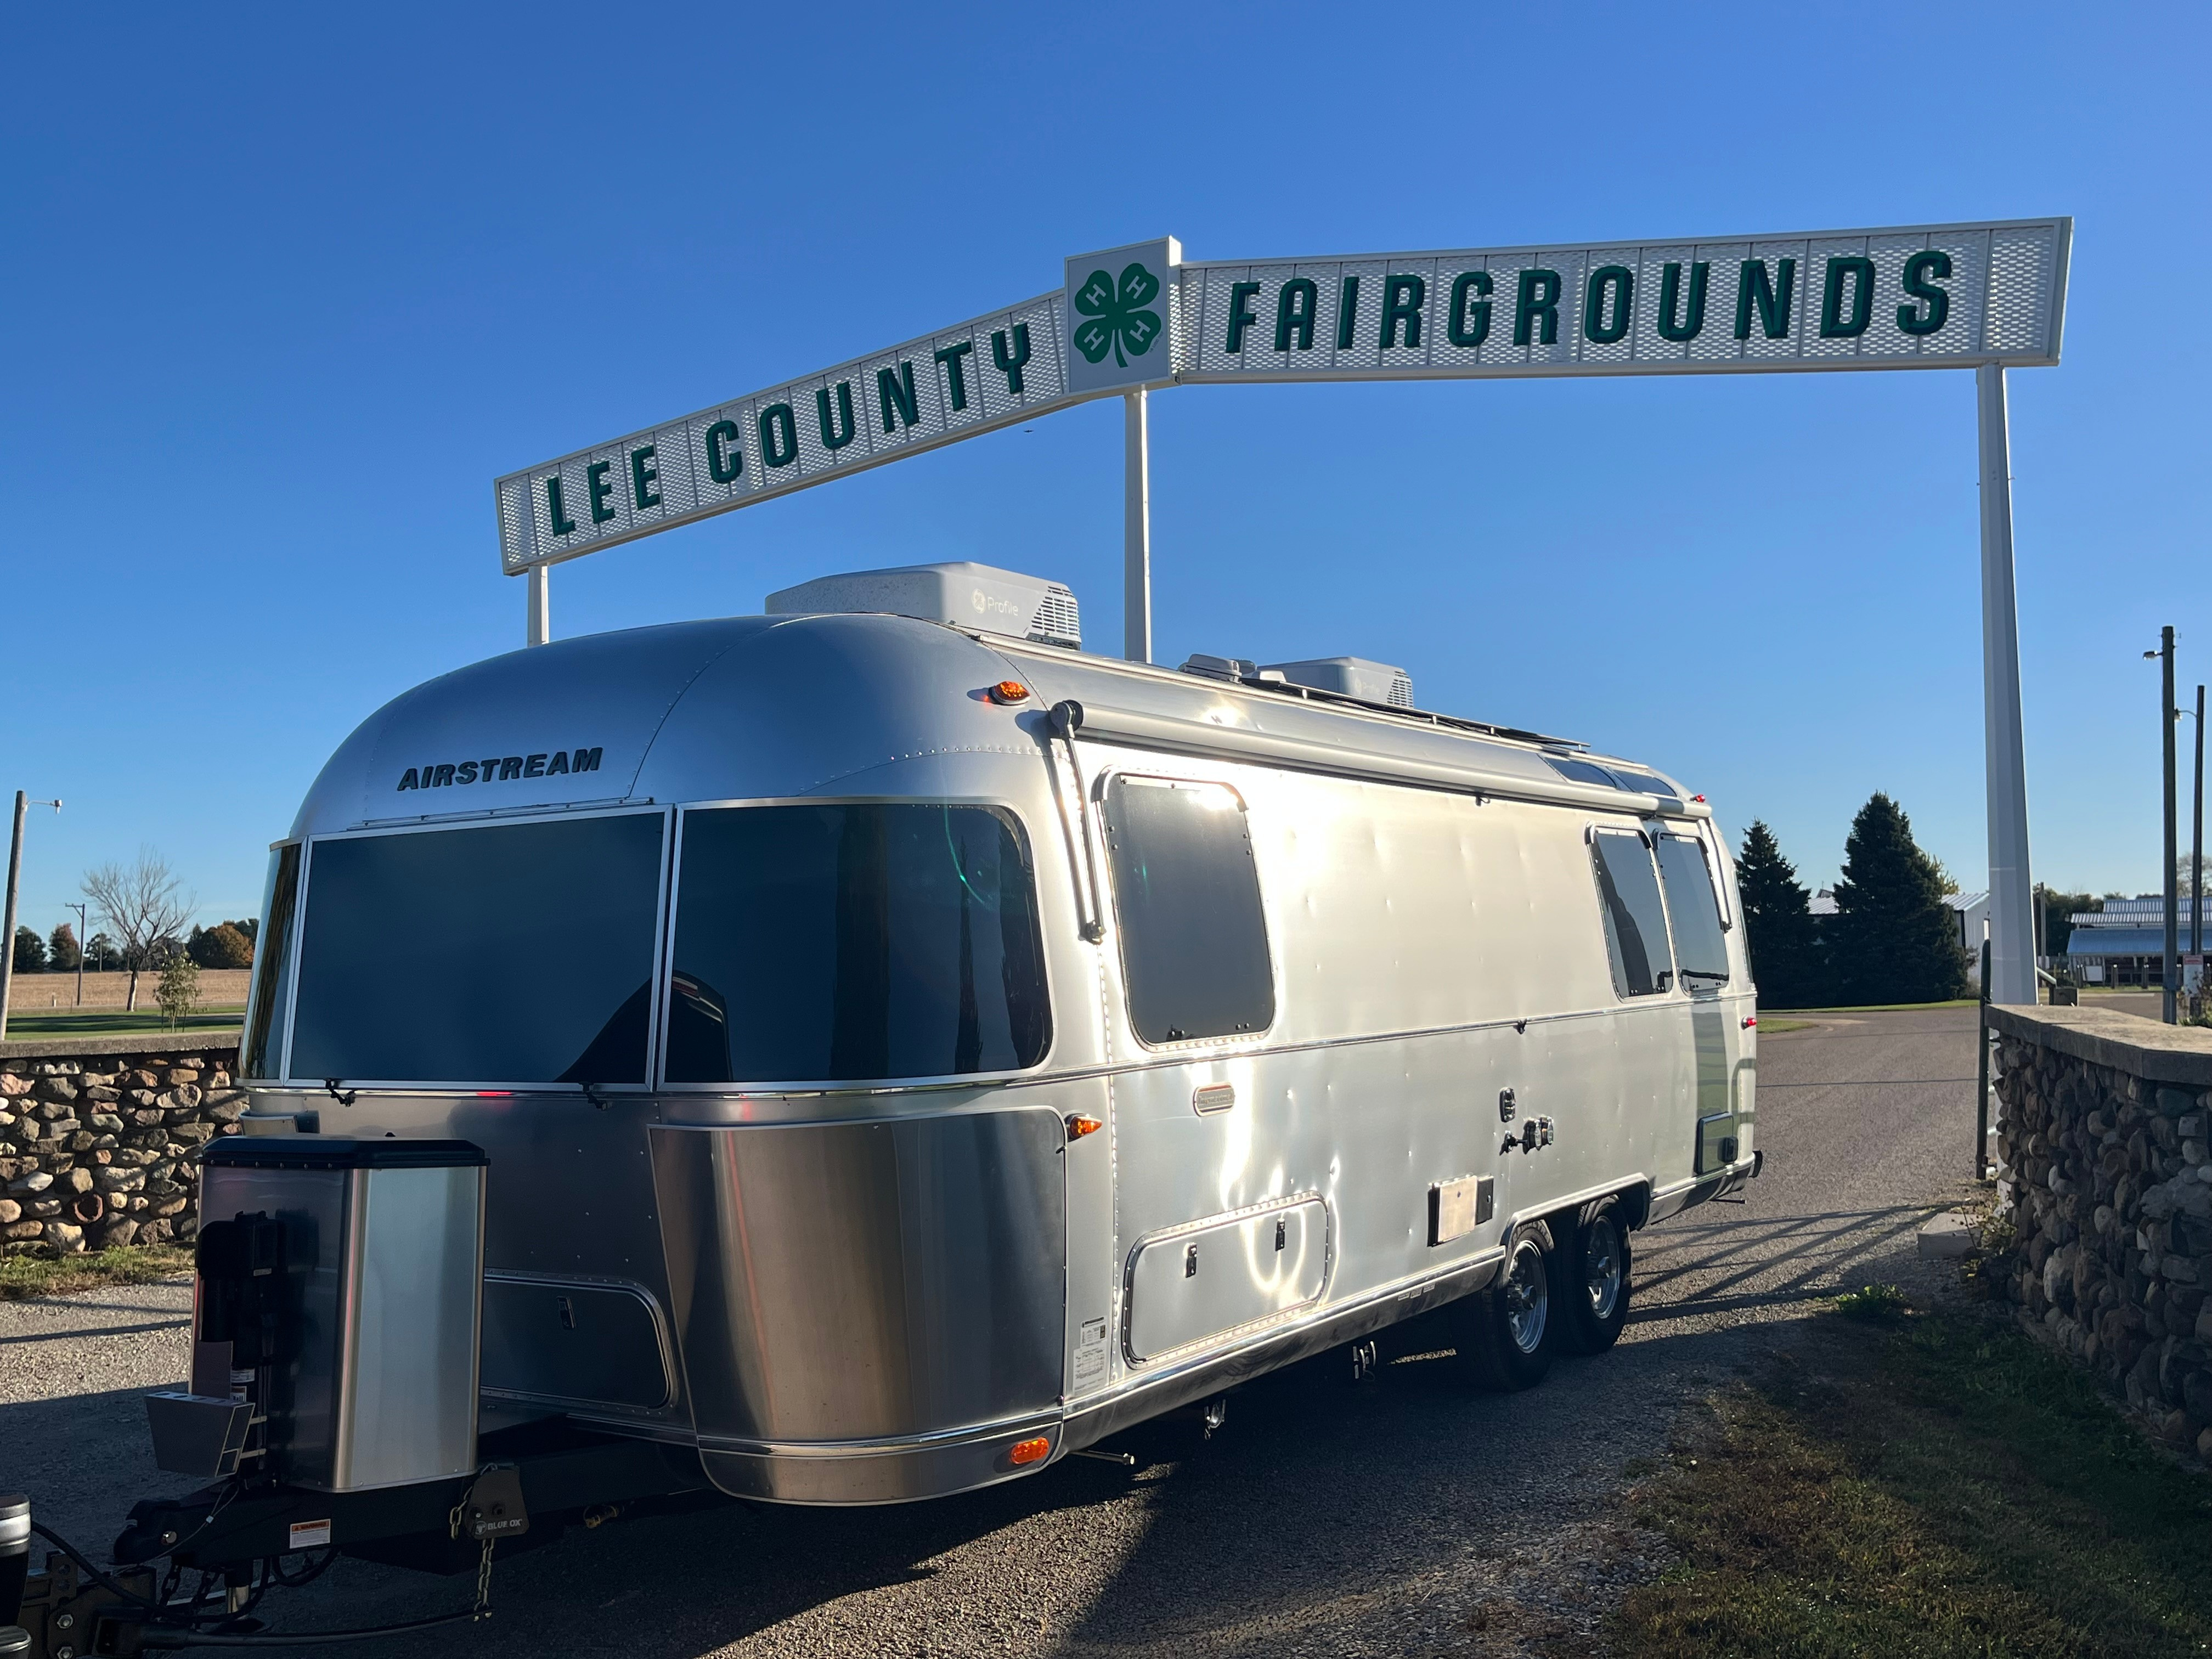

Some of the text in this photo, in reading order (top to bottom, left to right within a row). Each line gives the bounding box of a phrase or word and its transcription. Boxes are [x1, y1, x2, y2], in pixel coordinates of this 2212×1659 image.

[1086, 284, 1106, 307] H
[1126, 275, 1147, 299] H
[1226, 250, 1952, 353] FAIRGROUNDS
[1084, 327, 1104, 351] H
[1129, 320, 1150, 342] H
[548, 323, 1031, 537] LEE COUNTY
[988, 597, 1018, 616] Profile
[397, 747, 603, 791] AIRSTREAM
[488, 1519, 521, 1530] BLUE OX
